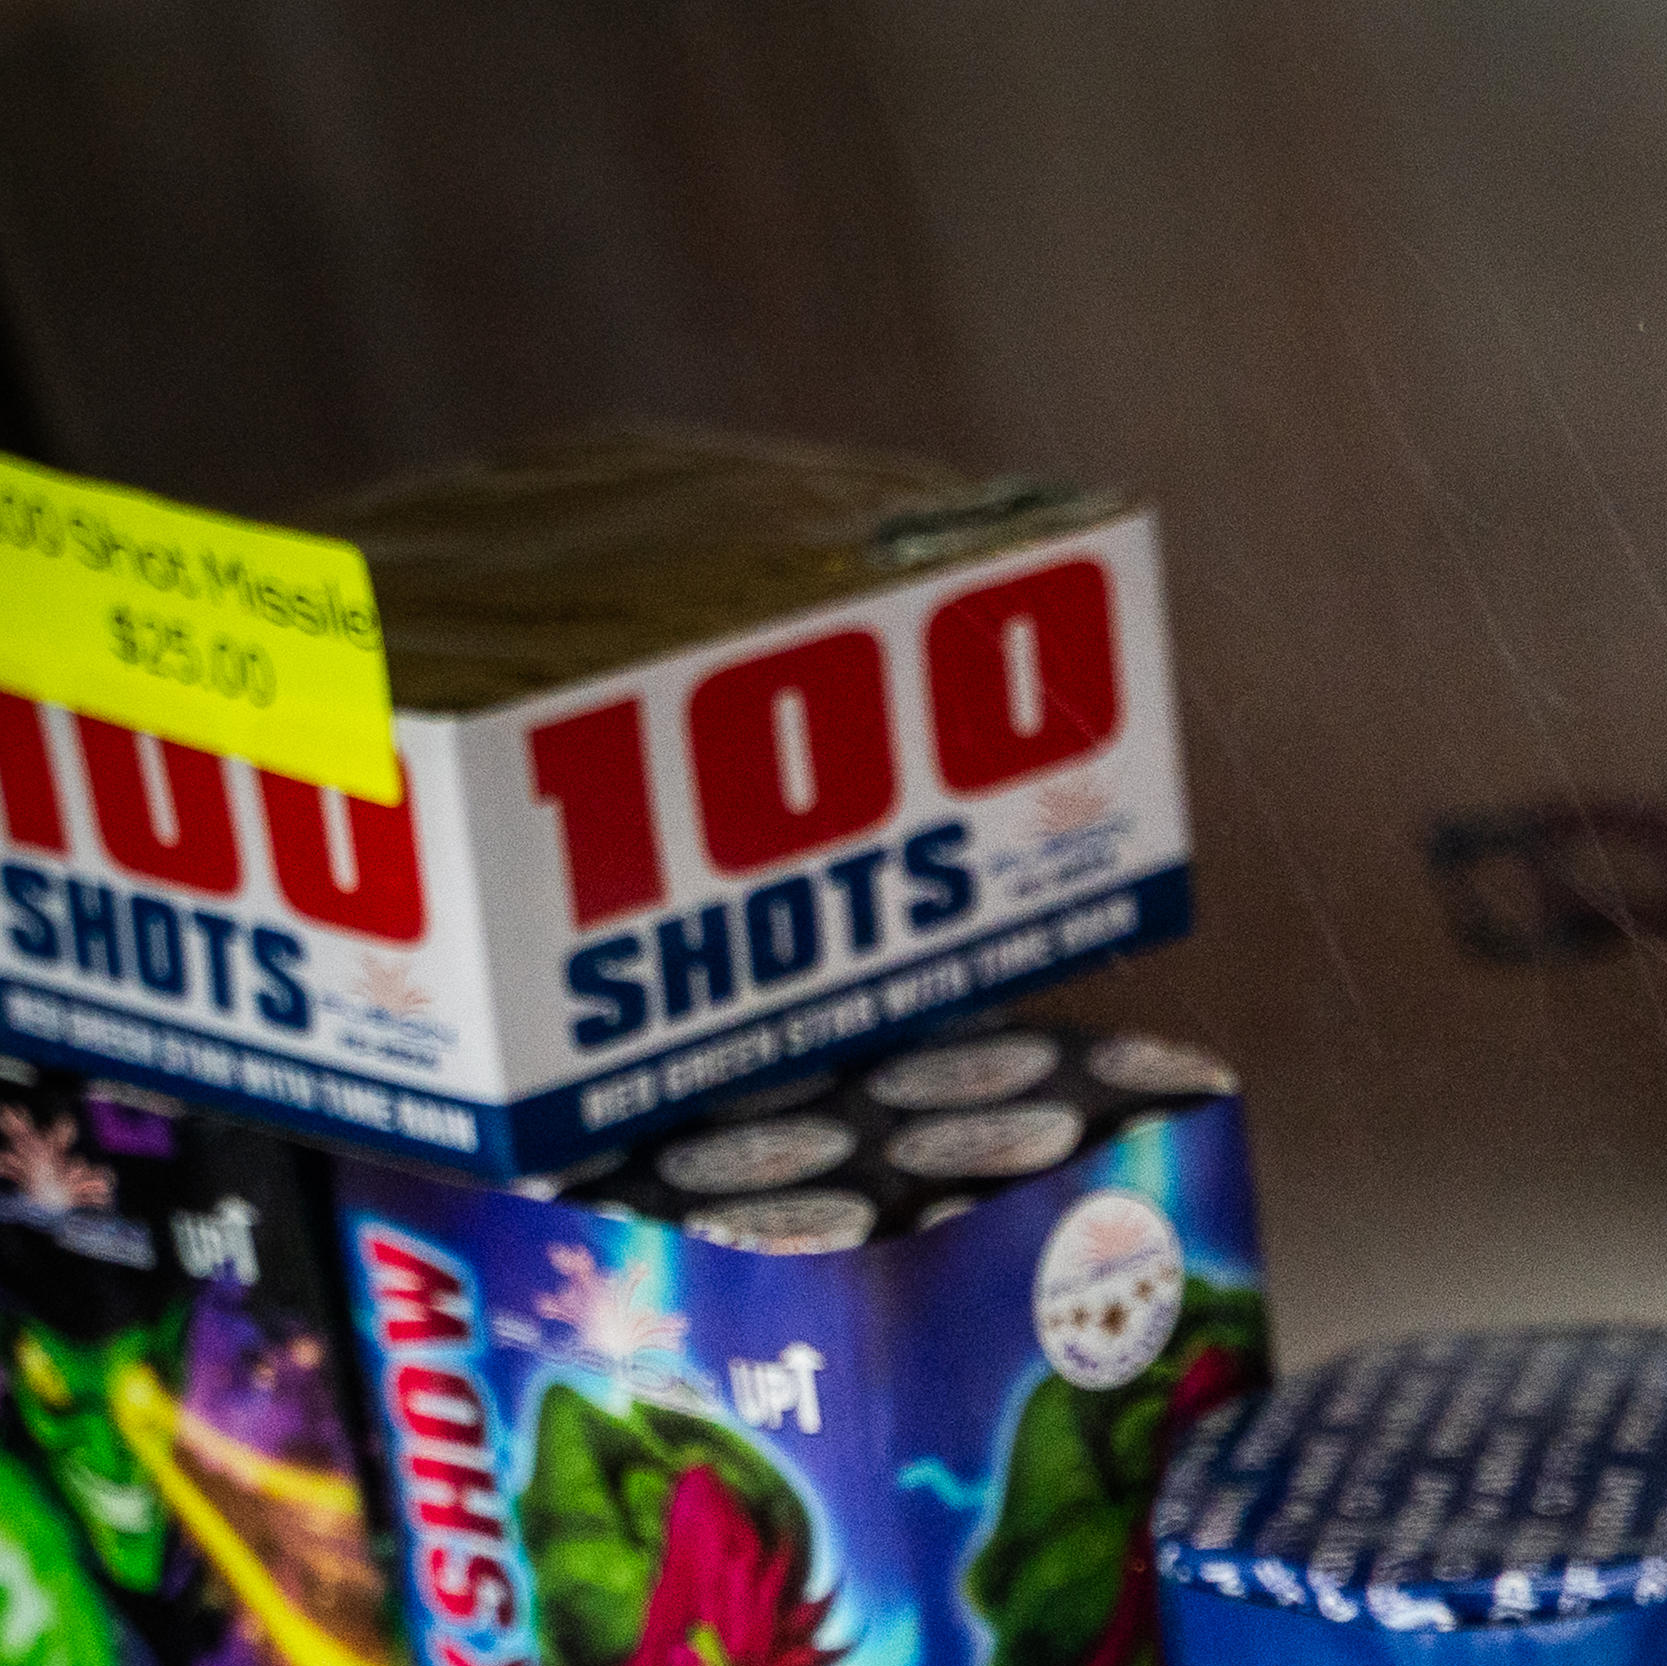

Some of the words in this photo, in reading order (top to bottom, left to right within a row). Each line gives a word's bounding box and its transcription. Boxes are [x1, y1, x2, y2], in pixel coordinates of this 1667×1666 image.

[526, 553, 1126, 934] 100
[2, 860, 312, 1034] SHOTS
[566, 819, 979, 1052] SHOTS
